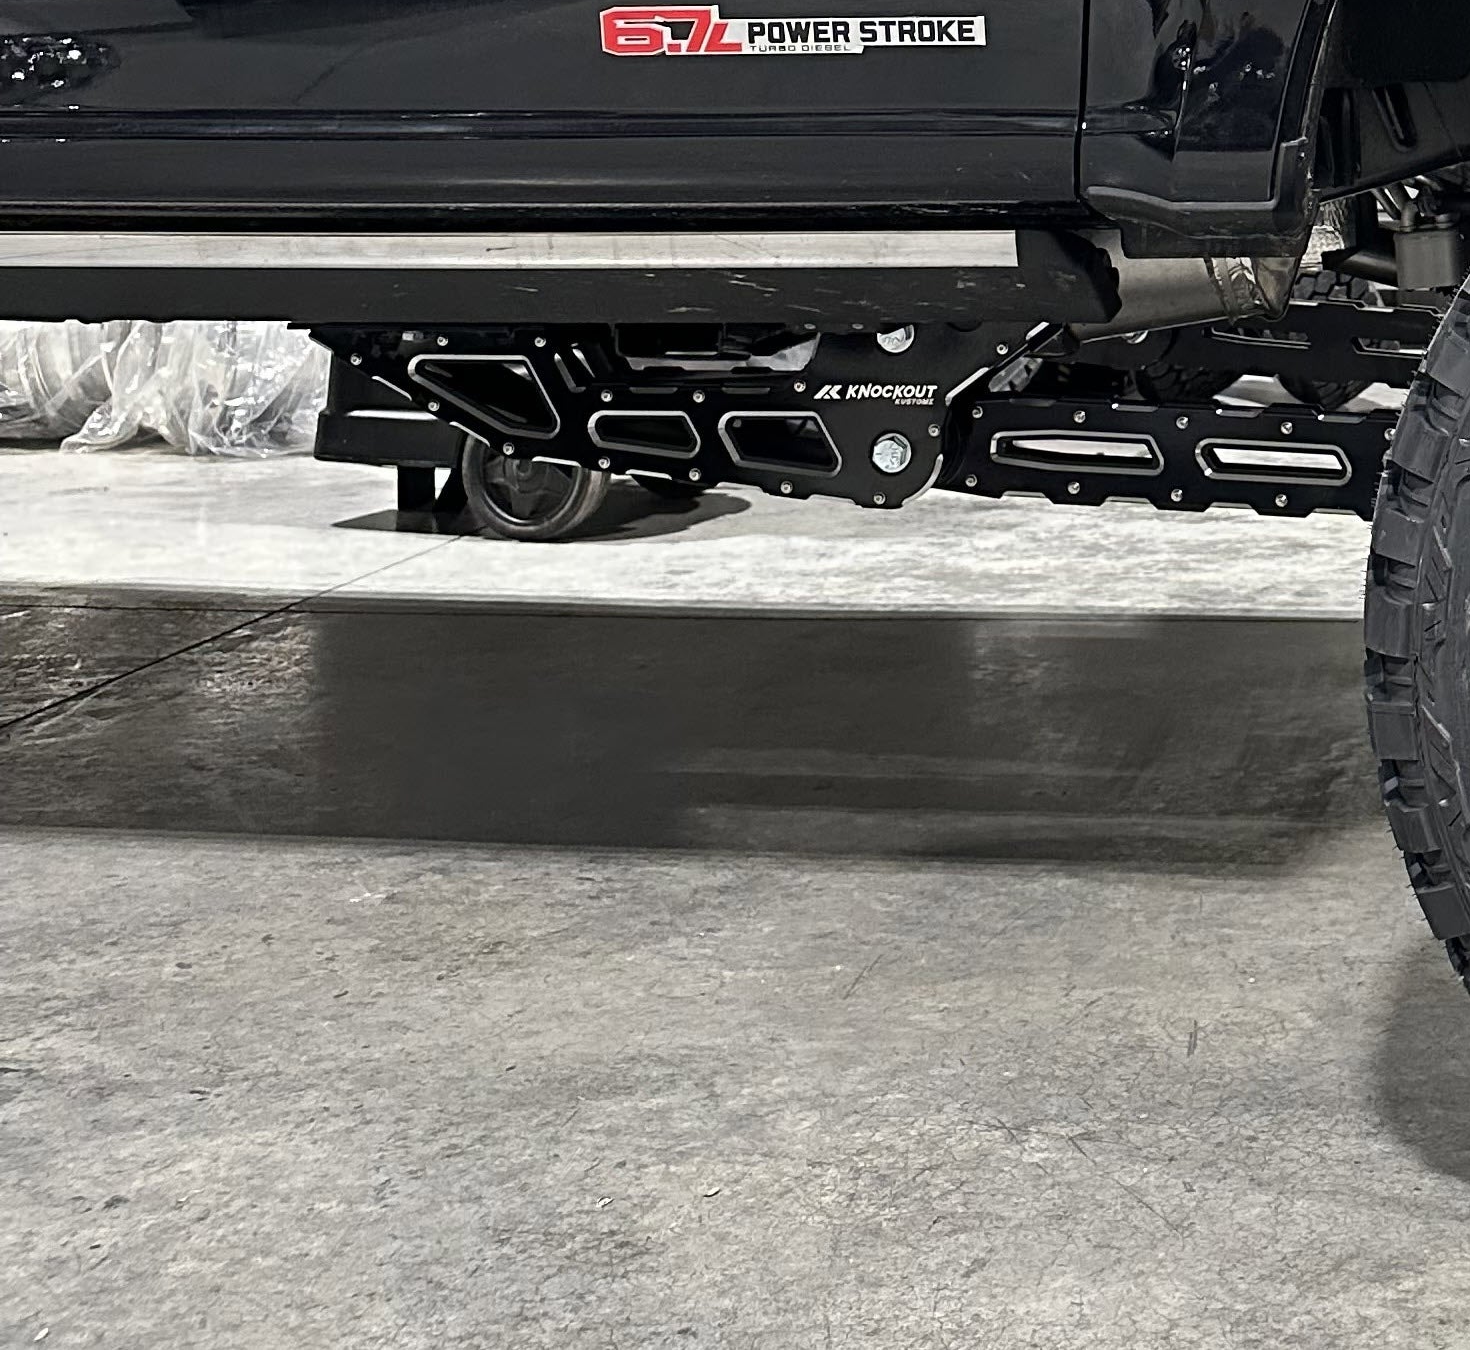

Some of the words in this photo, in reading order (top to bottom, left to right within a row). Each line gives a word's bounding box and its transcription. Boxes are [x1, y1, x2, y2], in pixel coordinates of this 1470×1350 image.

[601, 8, 743, 54] 6.7L
[747, 21, 851, 44] POWER
[859, 20, 976, 42] STROKE
[845, 383, 938, 400] KNOCKOUT
